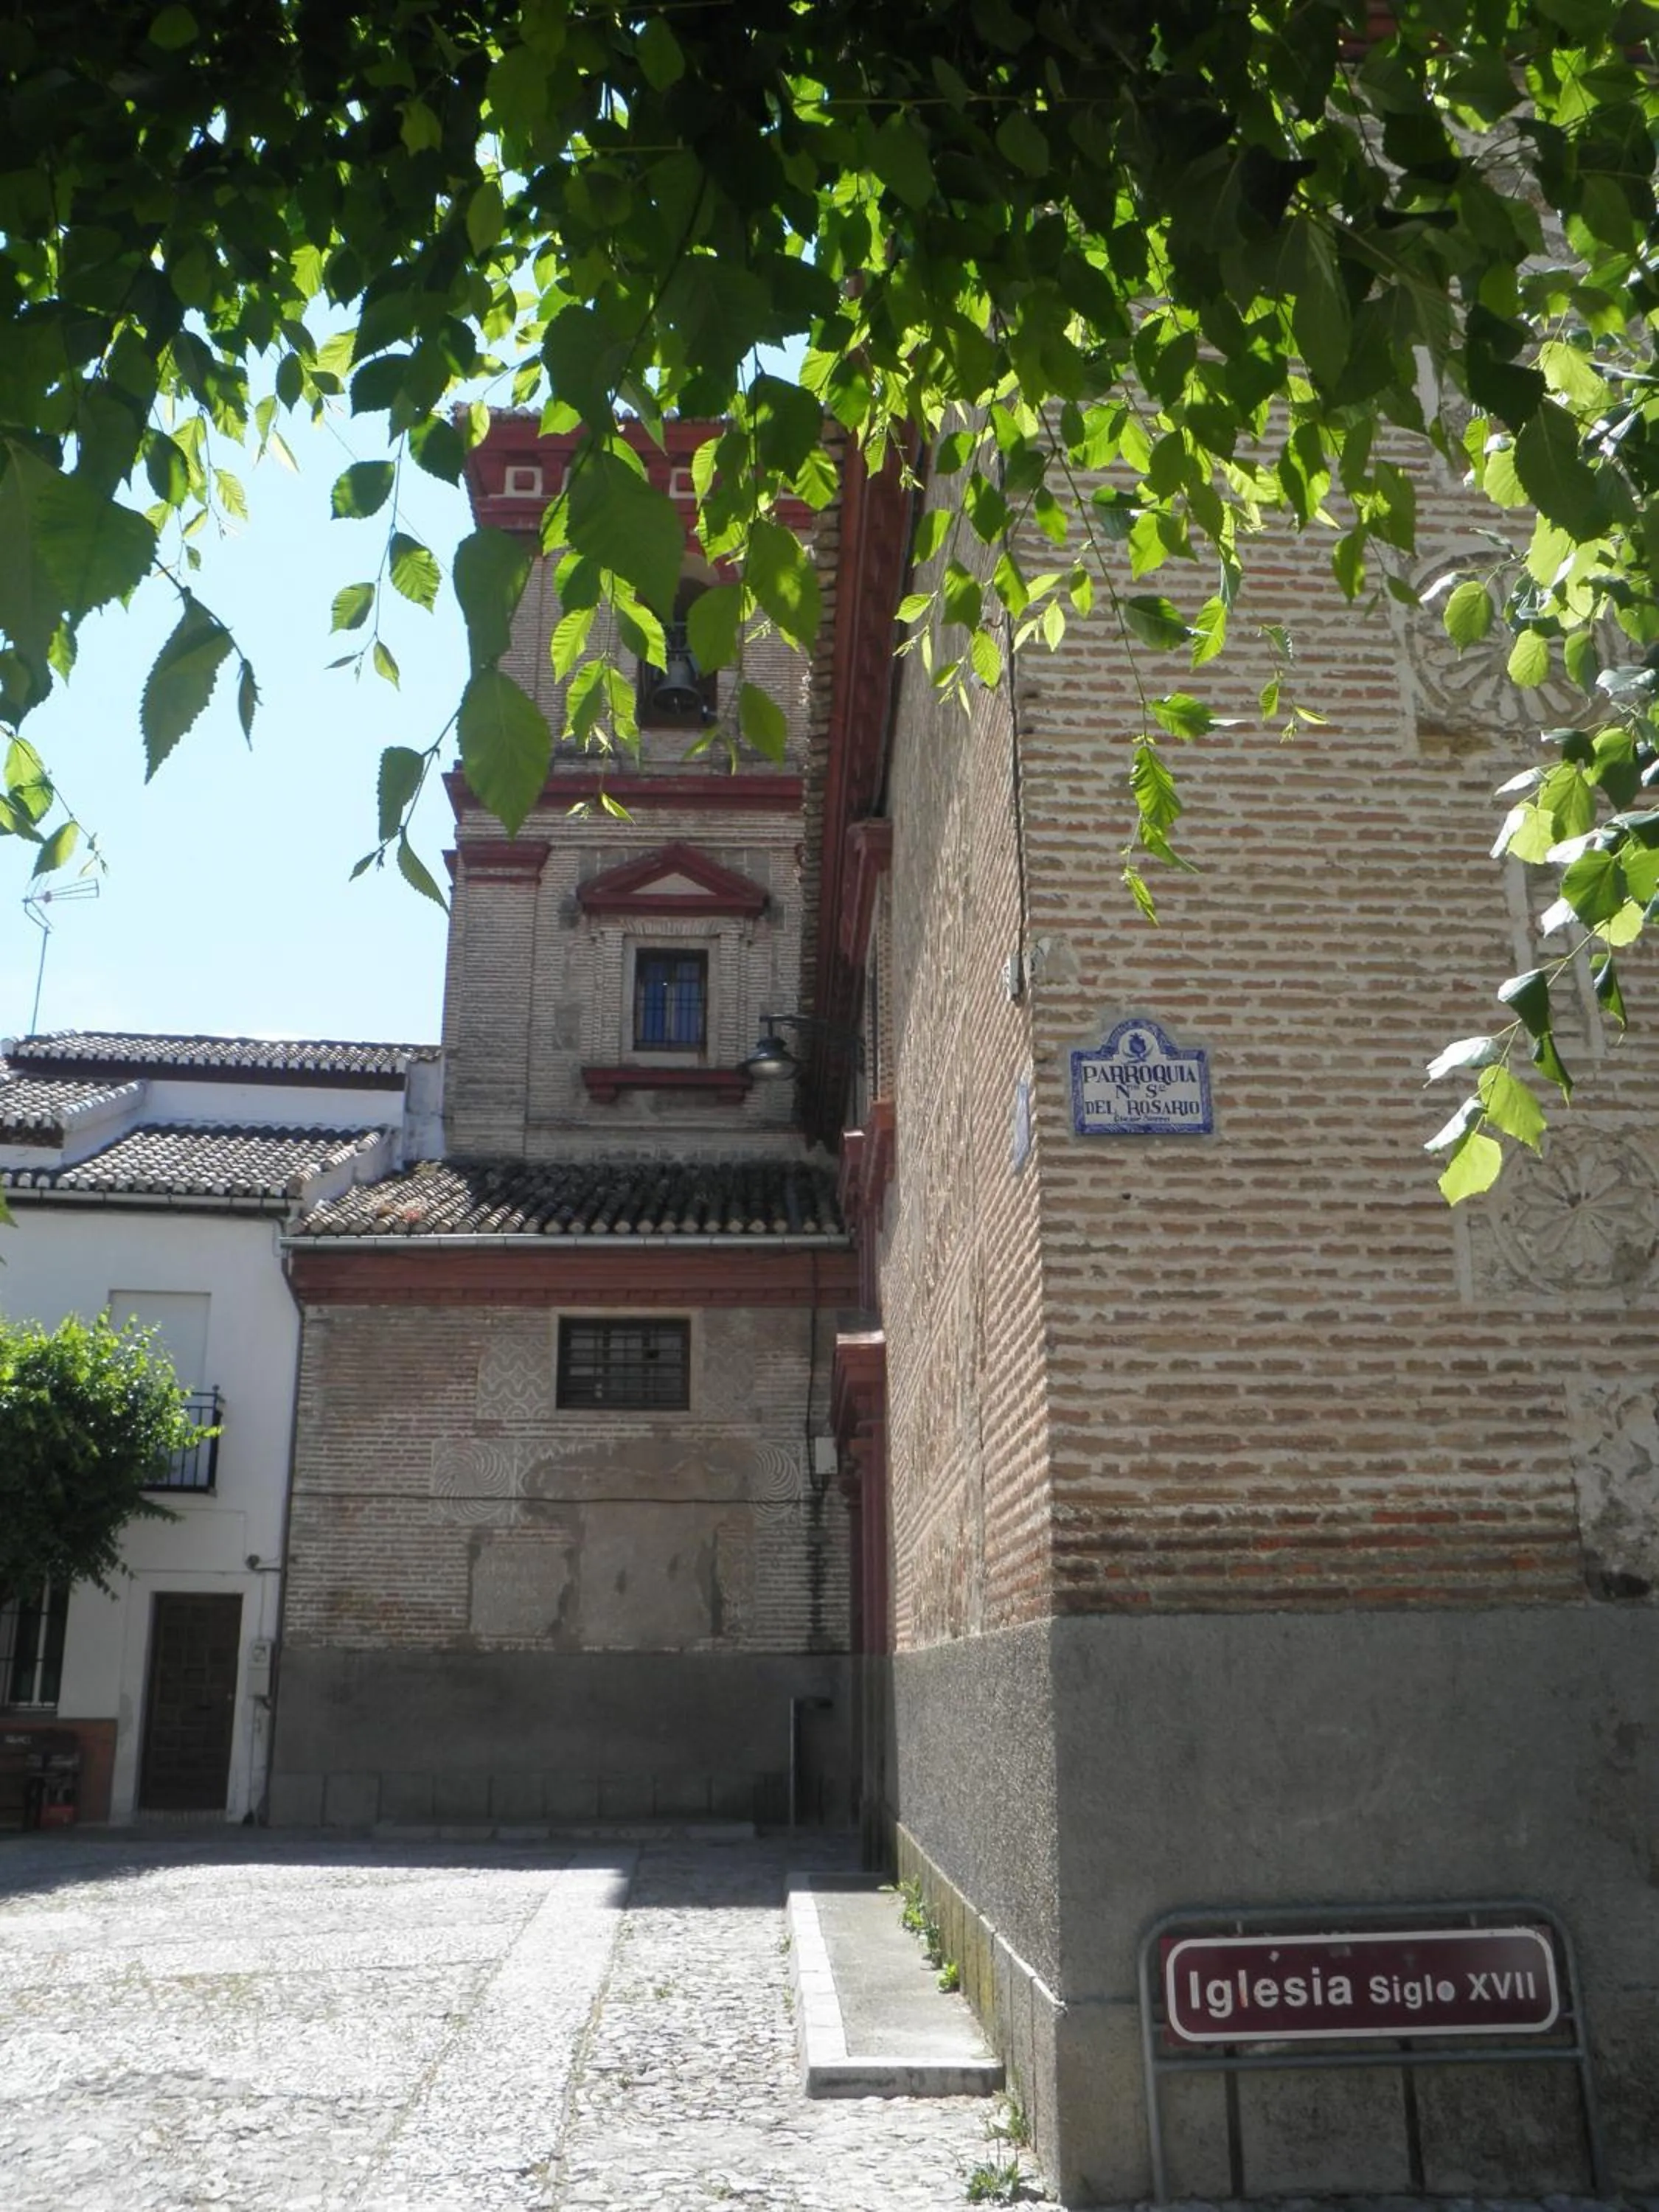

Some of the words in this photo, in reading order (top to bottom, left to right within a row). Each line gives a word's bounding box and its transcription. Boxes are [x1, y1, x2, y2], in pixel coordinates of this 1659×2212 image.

[1082, 1065, 1197, 1085] PARROQUIA
[1085, 1101, 1116, 1115] DEL
[1127, 1100, 1200, 1116] ROSARIO
[1189, 1967, 1354, 2018] Iglesia
[1369, 1975, 1455, 2010] Siglo
[1467, 1972, 1537, 2001] XVII
